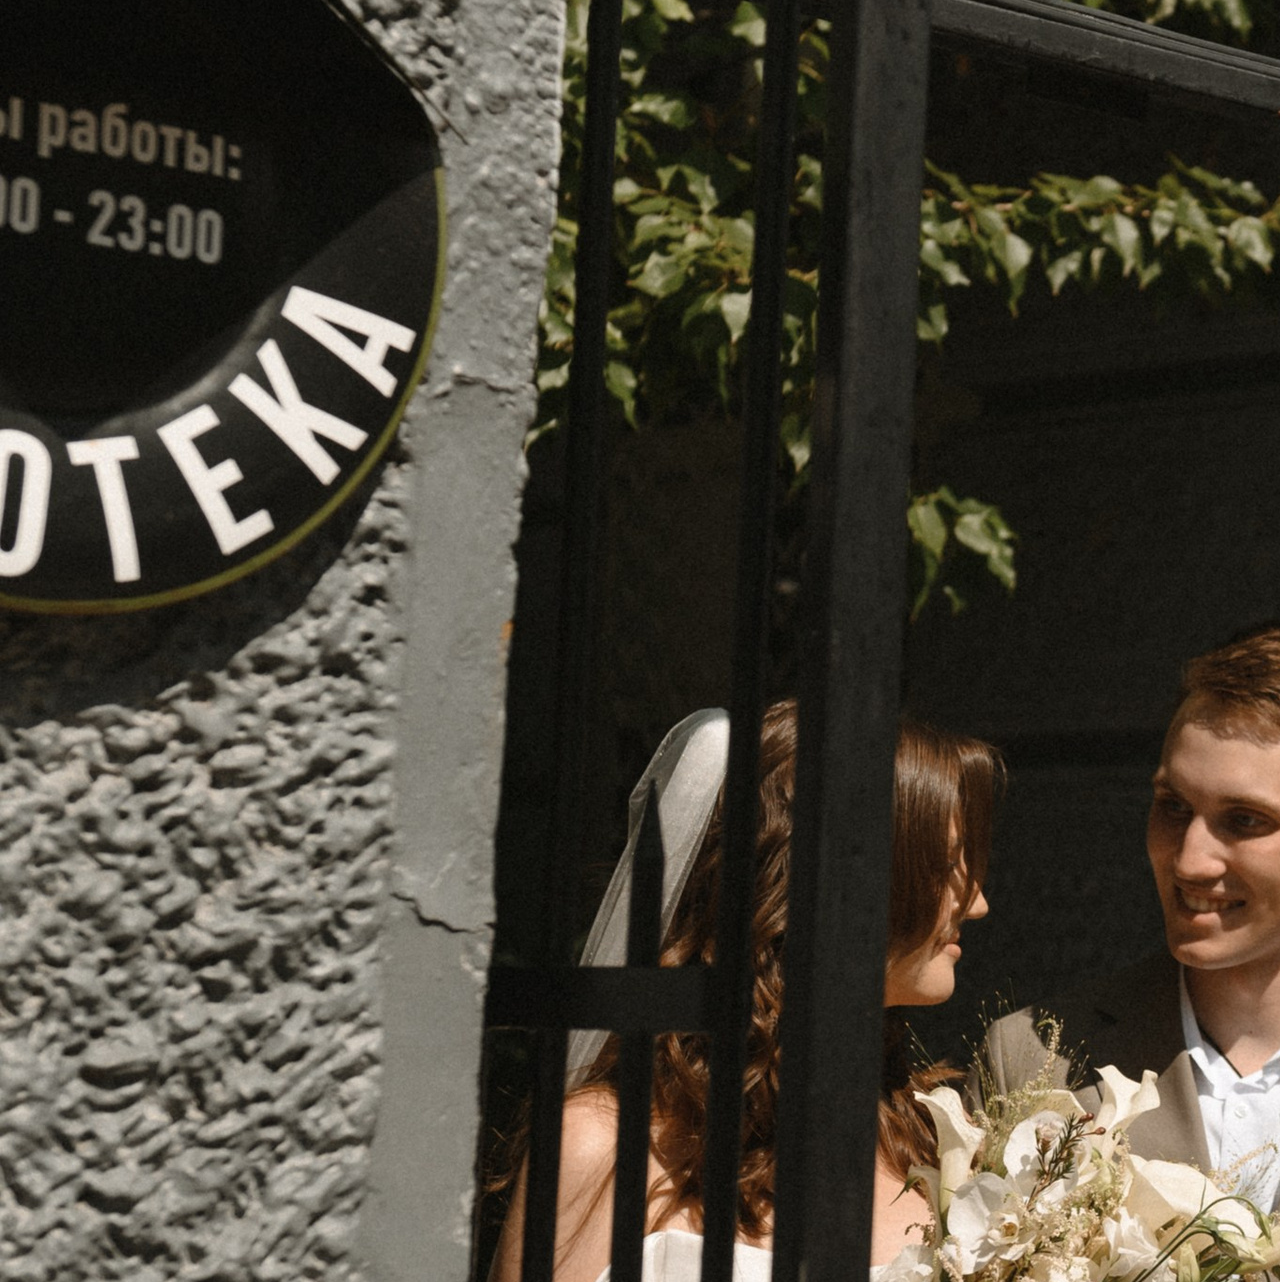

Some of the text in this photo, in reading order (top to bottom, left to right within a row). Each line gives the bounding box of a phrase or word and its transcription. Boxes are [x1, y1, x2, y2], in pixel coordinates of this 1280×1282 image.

[37, 101, 243, 181] работы:
[0, 173, 41, 234] 0
[86, 189, 225, 265] 23:00
[0, 285, 417, 583] ОТЕКА
